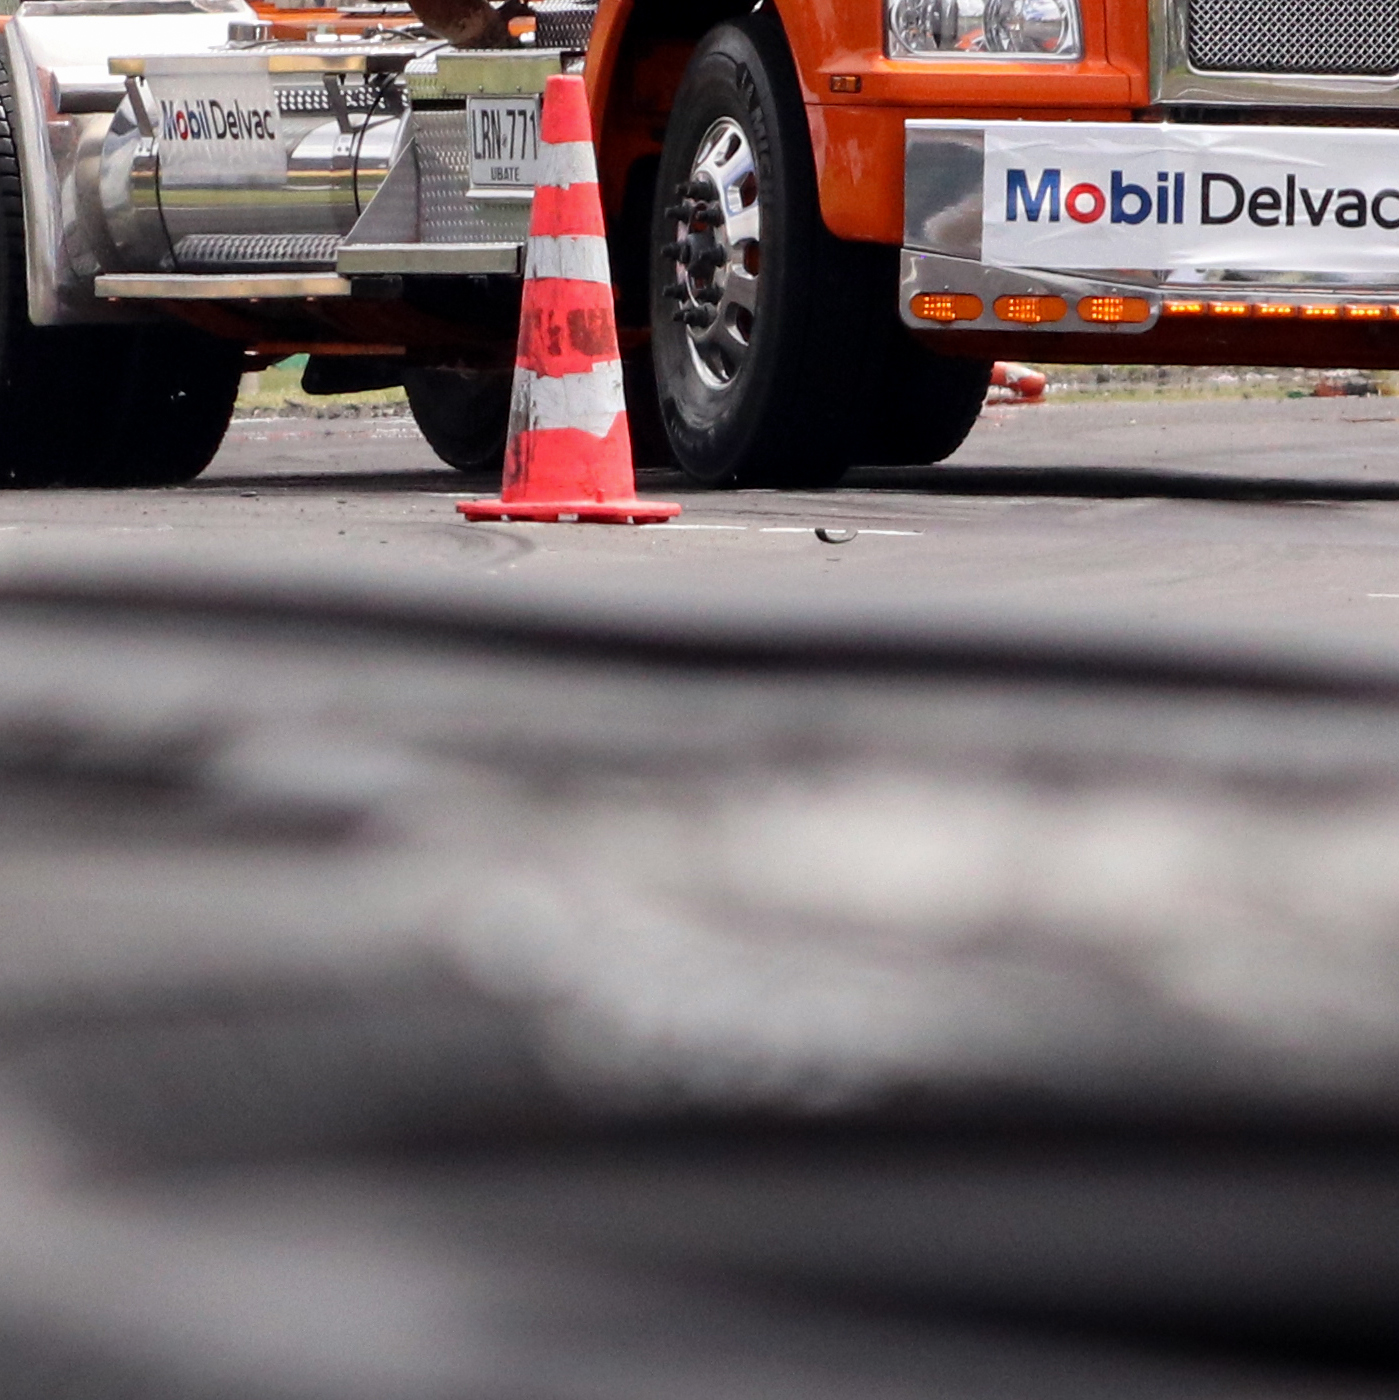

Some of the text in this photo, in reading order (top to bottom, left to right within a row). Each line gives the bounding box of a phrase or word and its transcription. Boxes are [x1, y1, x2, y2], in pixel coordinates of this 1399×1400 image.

[160, 99, 276, 141] Mobil Delvac
[1004, 167, 1186, 226] Mobil
